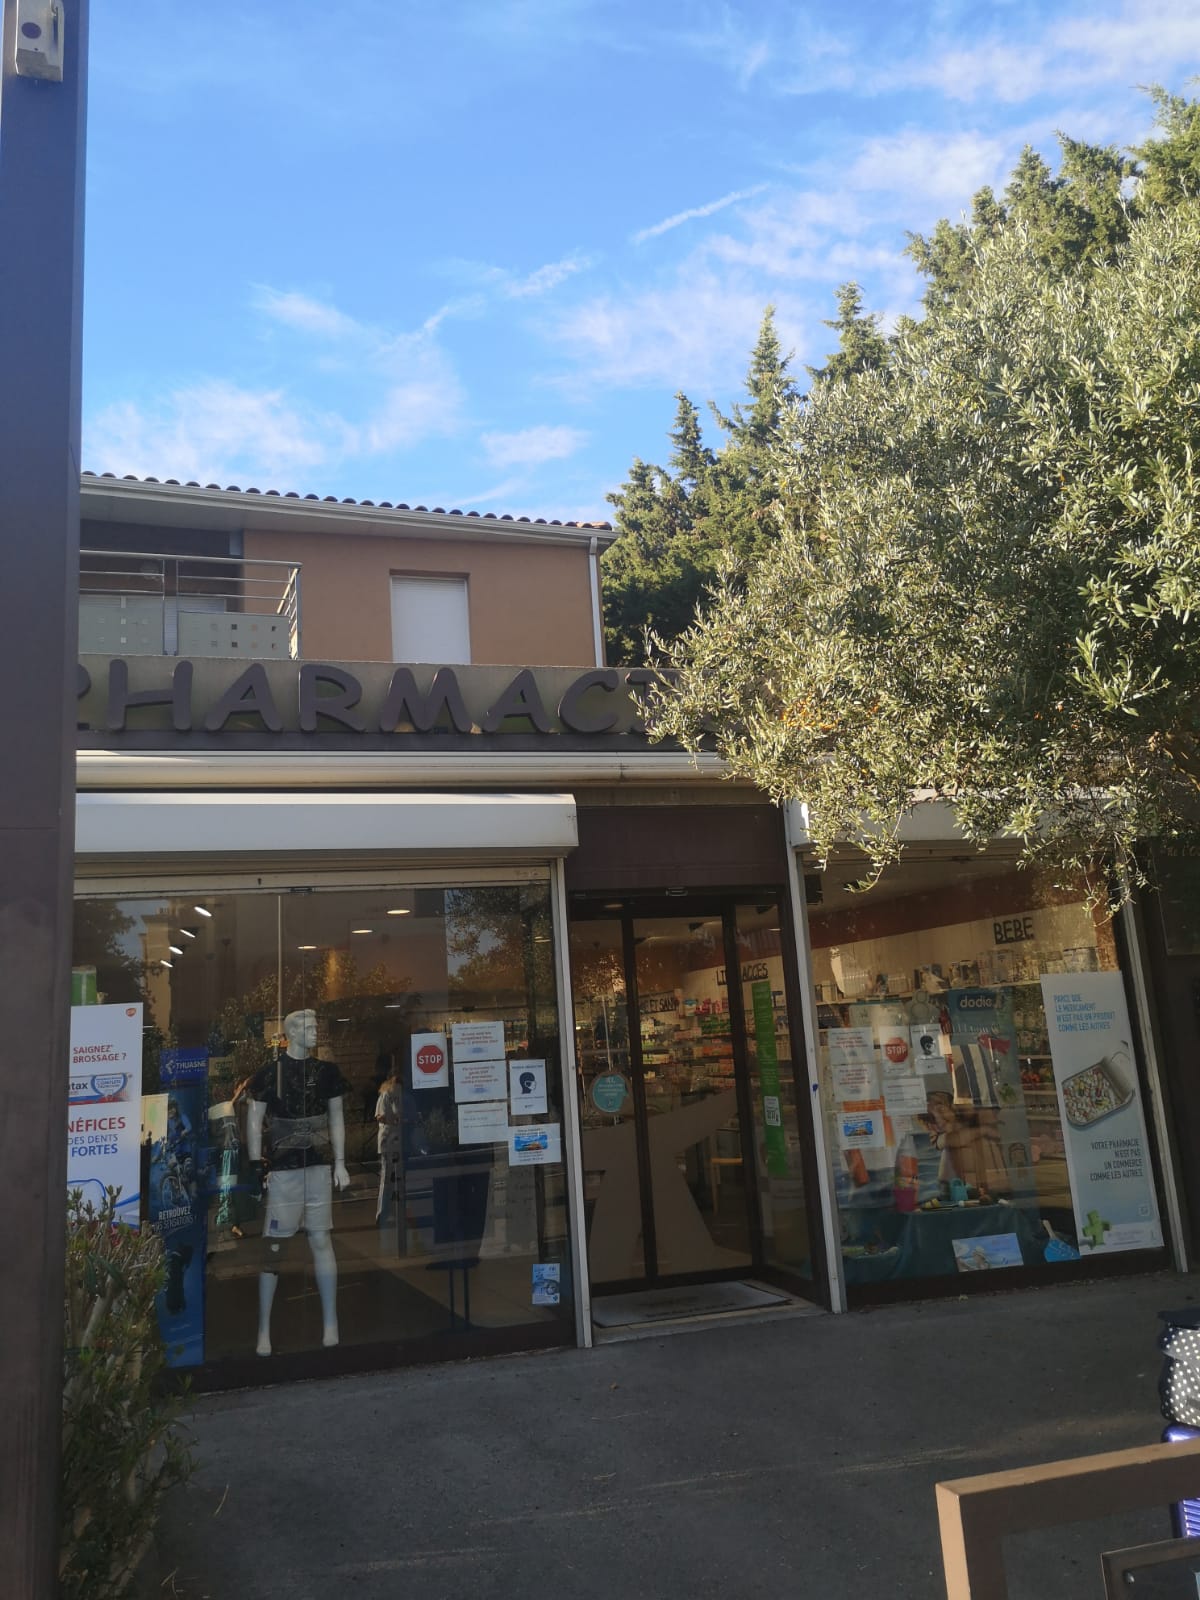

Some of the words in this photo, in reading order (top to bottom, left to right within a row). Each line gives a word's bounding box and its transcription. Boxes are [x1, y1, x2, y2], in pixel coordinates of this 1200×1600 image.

[993, 917, 1034, 944] BEBE
[886, 1046, 907, 1056] STOP
[73, 1053, 119, 1064] BROSSAGE
[418, 1054, 442, 1066] STOP
[176, 1060, 207, 1070] THUASNE
[87, 1133, 119, 1144] DENTS
[71, 1143, 118, 1157] FORTES
[158, 1206, 191, 1221] RETROUVEZ
